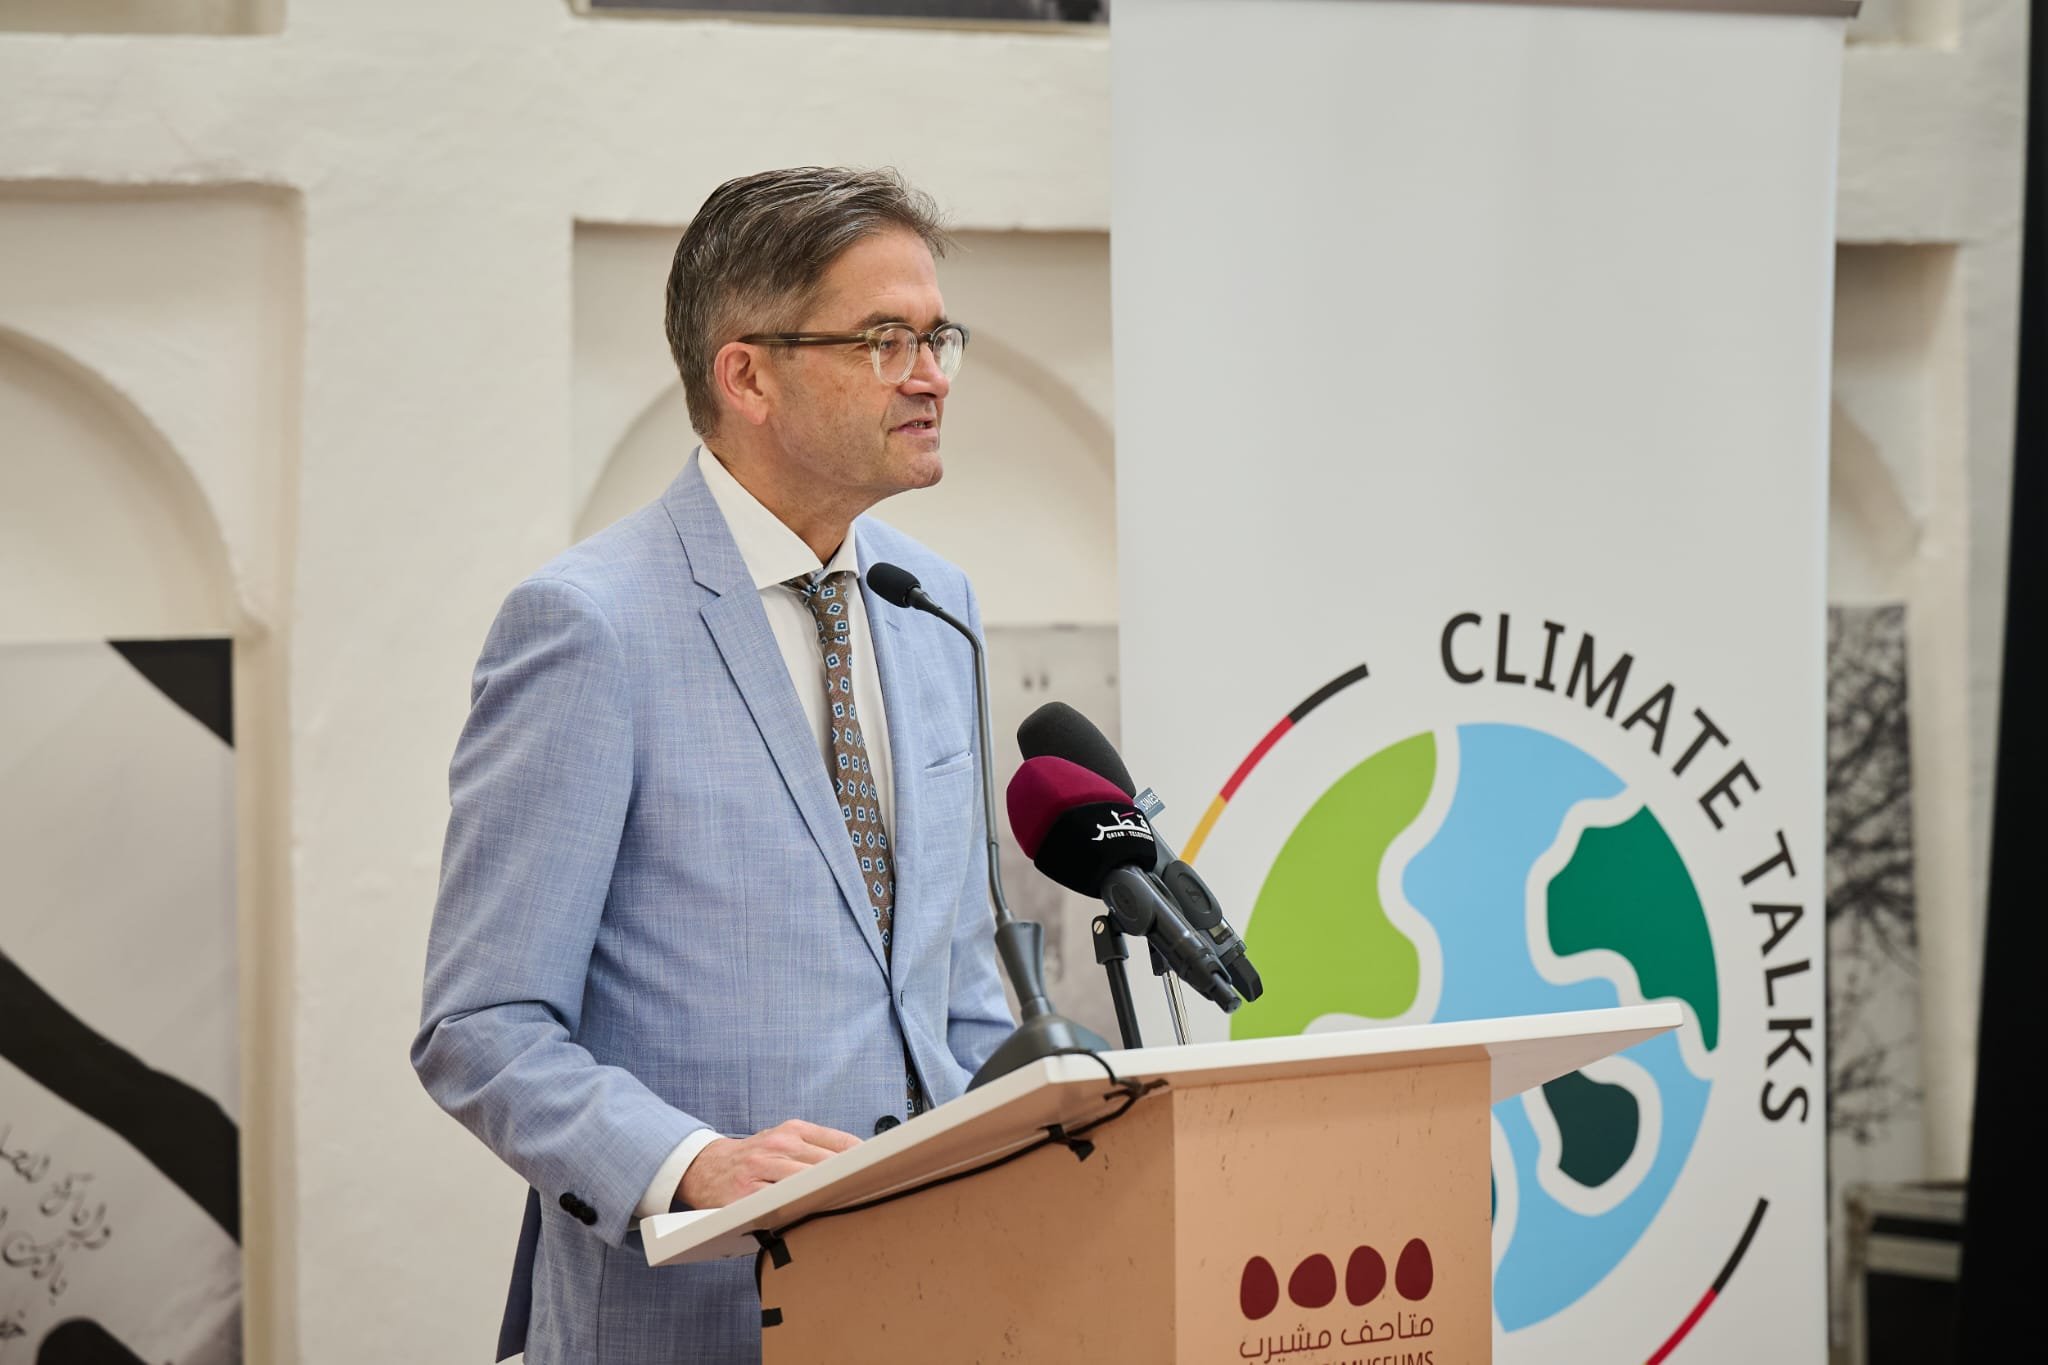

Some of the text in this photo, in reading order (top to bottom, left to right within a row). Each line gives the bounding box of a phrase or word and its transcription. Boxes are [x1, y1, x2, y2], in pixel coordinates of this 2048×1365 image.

[1441, 612, 1813, 1123] CLIMATE TALKS
[1239, 1311, 1434, 1365] متاحف مشيرب
